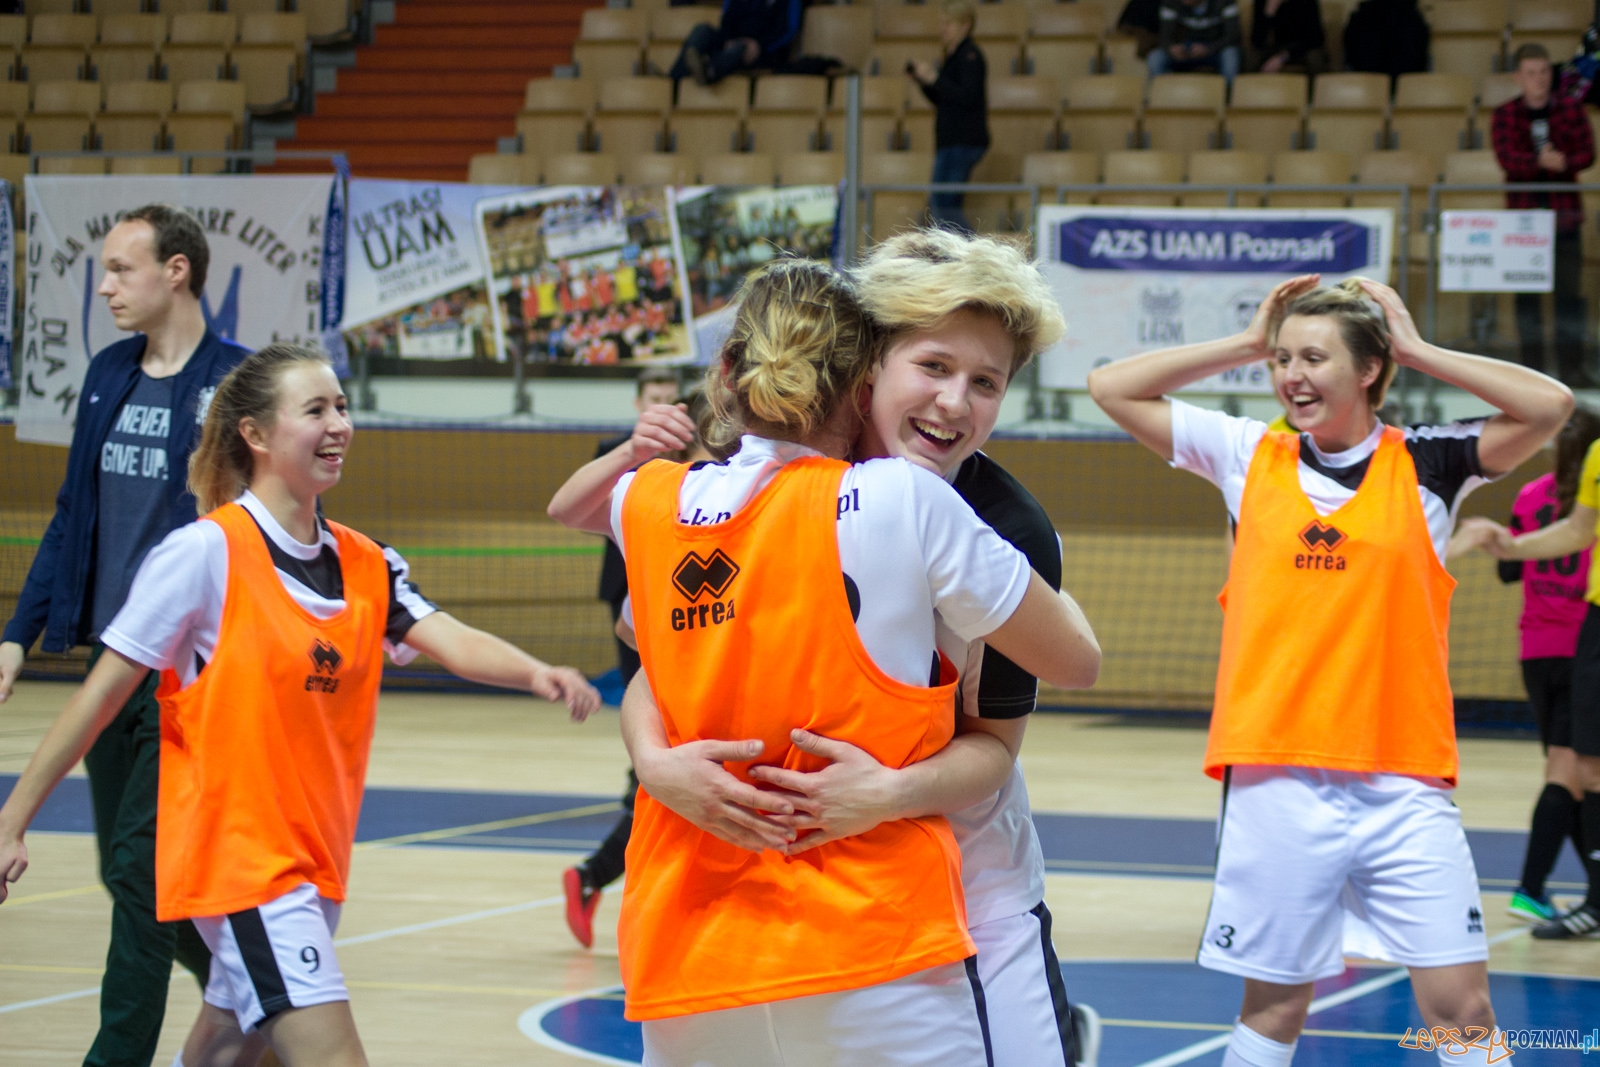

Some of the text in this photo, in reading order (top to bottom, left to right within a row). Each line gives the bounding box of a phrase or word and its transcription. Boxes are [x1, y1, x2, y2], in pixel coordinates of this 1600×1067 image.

[361, 210, 457, 271] UAM
[1089, 229, 1336, 263] AZS UAM Poznań
[115, 403, 172, 439] NEVER
[101, 441, 141, 477] GIVE
[836, 487, 861, 521] pl
[1294, 553, 1347, 571] errea
[670, 598, 736, 632] errea
[1215, 924, 1236, 950] 3
[300, 945, 320, 974] 9
